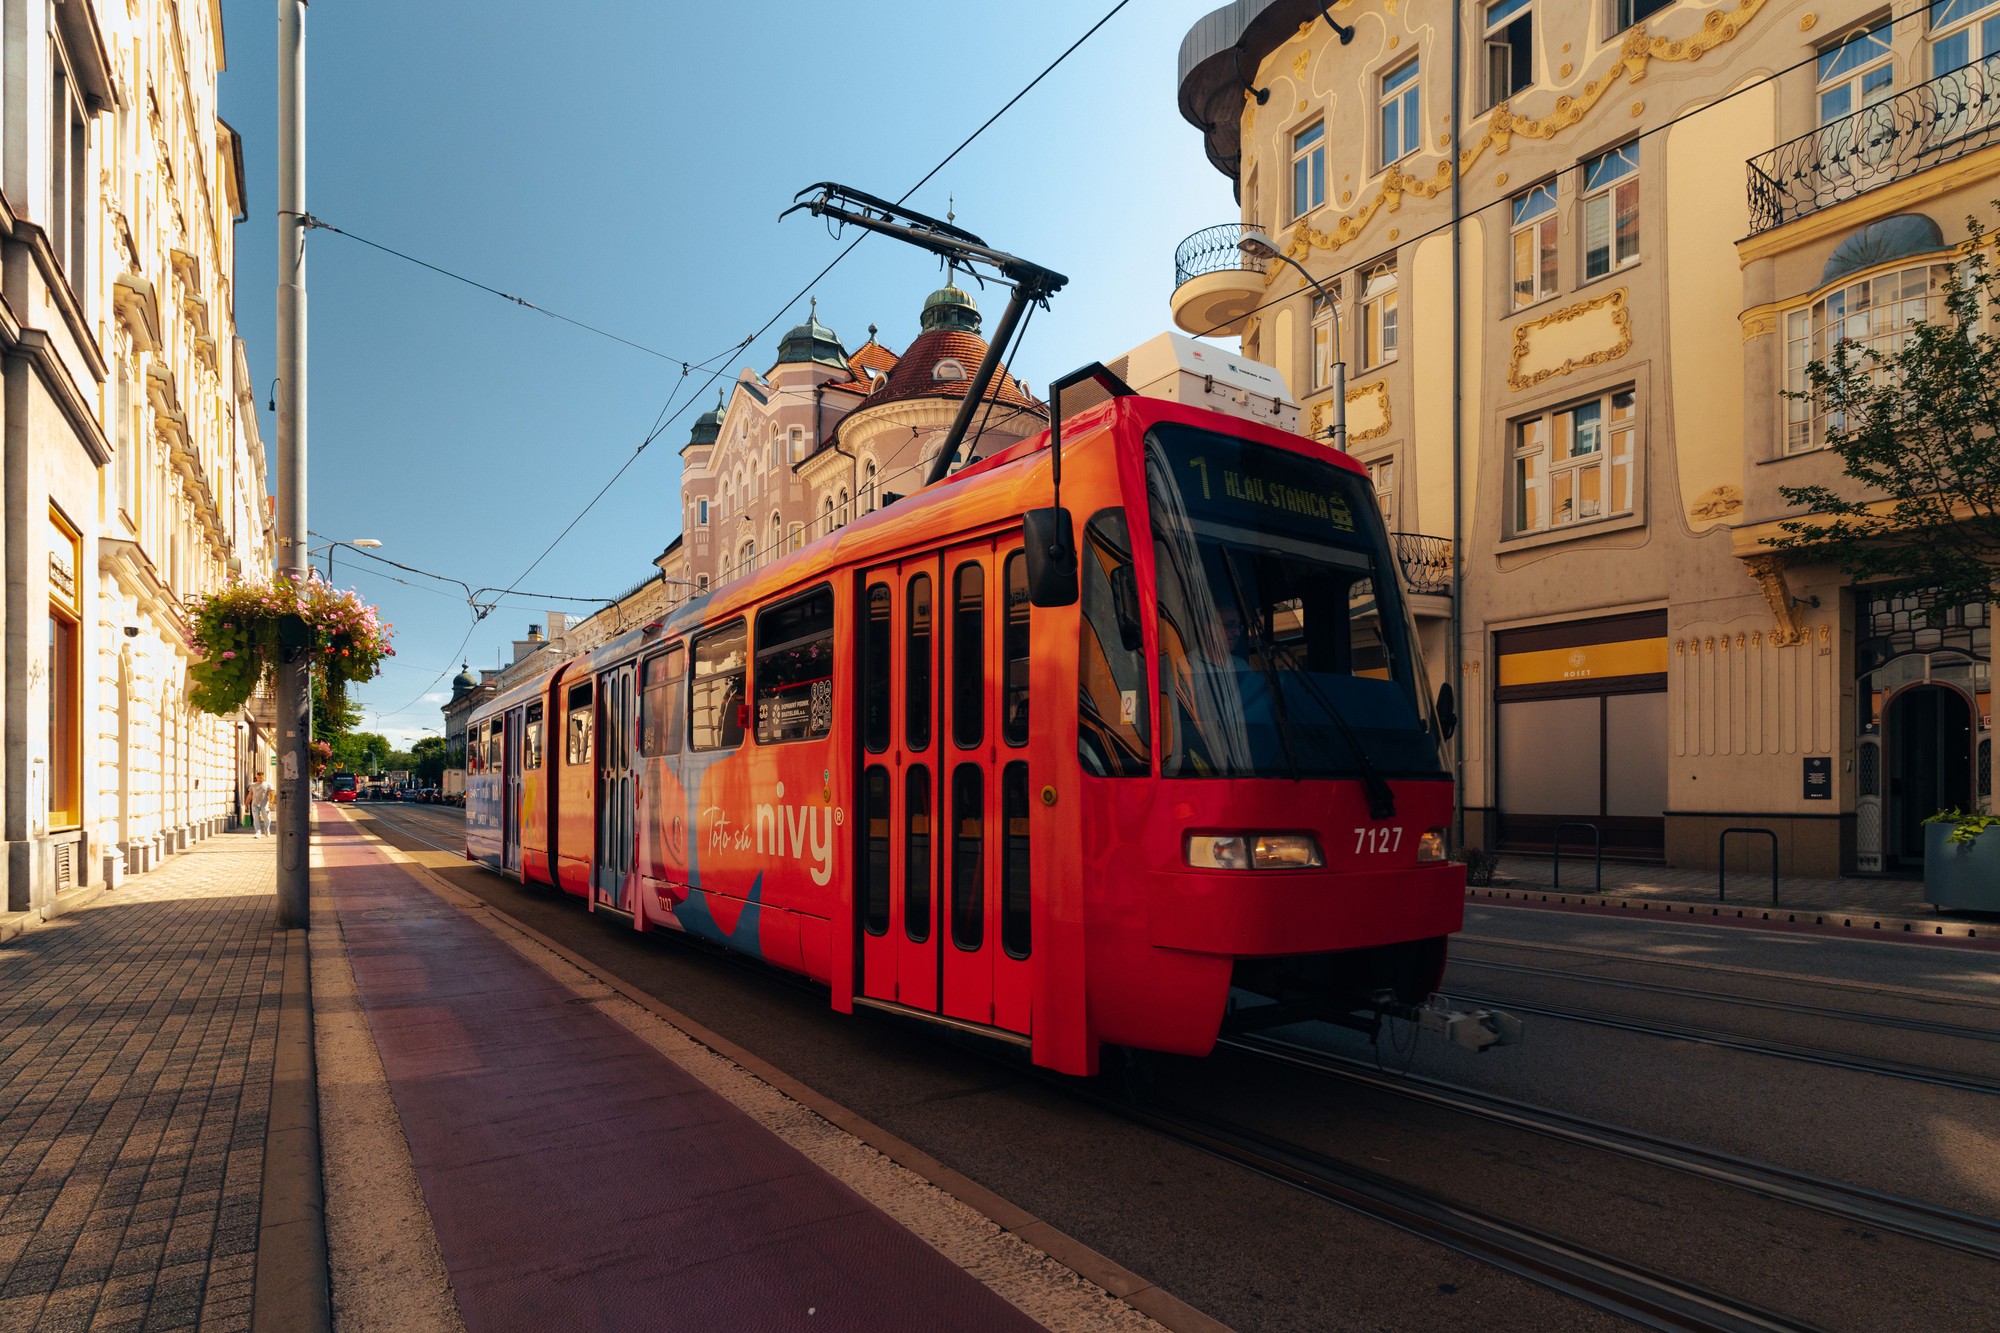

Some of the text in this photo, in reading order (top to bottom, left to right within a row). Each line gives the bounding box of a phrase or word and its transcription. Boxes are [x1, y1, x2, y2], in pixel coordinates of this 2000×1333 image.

[1190, 456, 1210, 499] 1
[1269, 482, 1329, 519] STANICA
[1125, 696, 1132, 716] 2
[703, 804, 731, 857] Toto
[734, 823, 752, 851] sú
[1354, 827, 1402, 854] 7127
[659, 896, 672, 911] 7127
